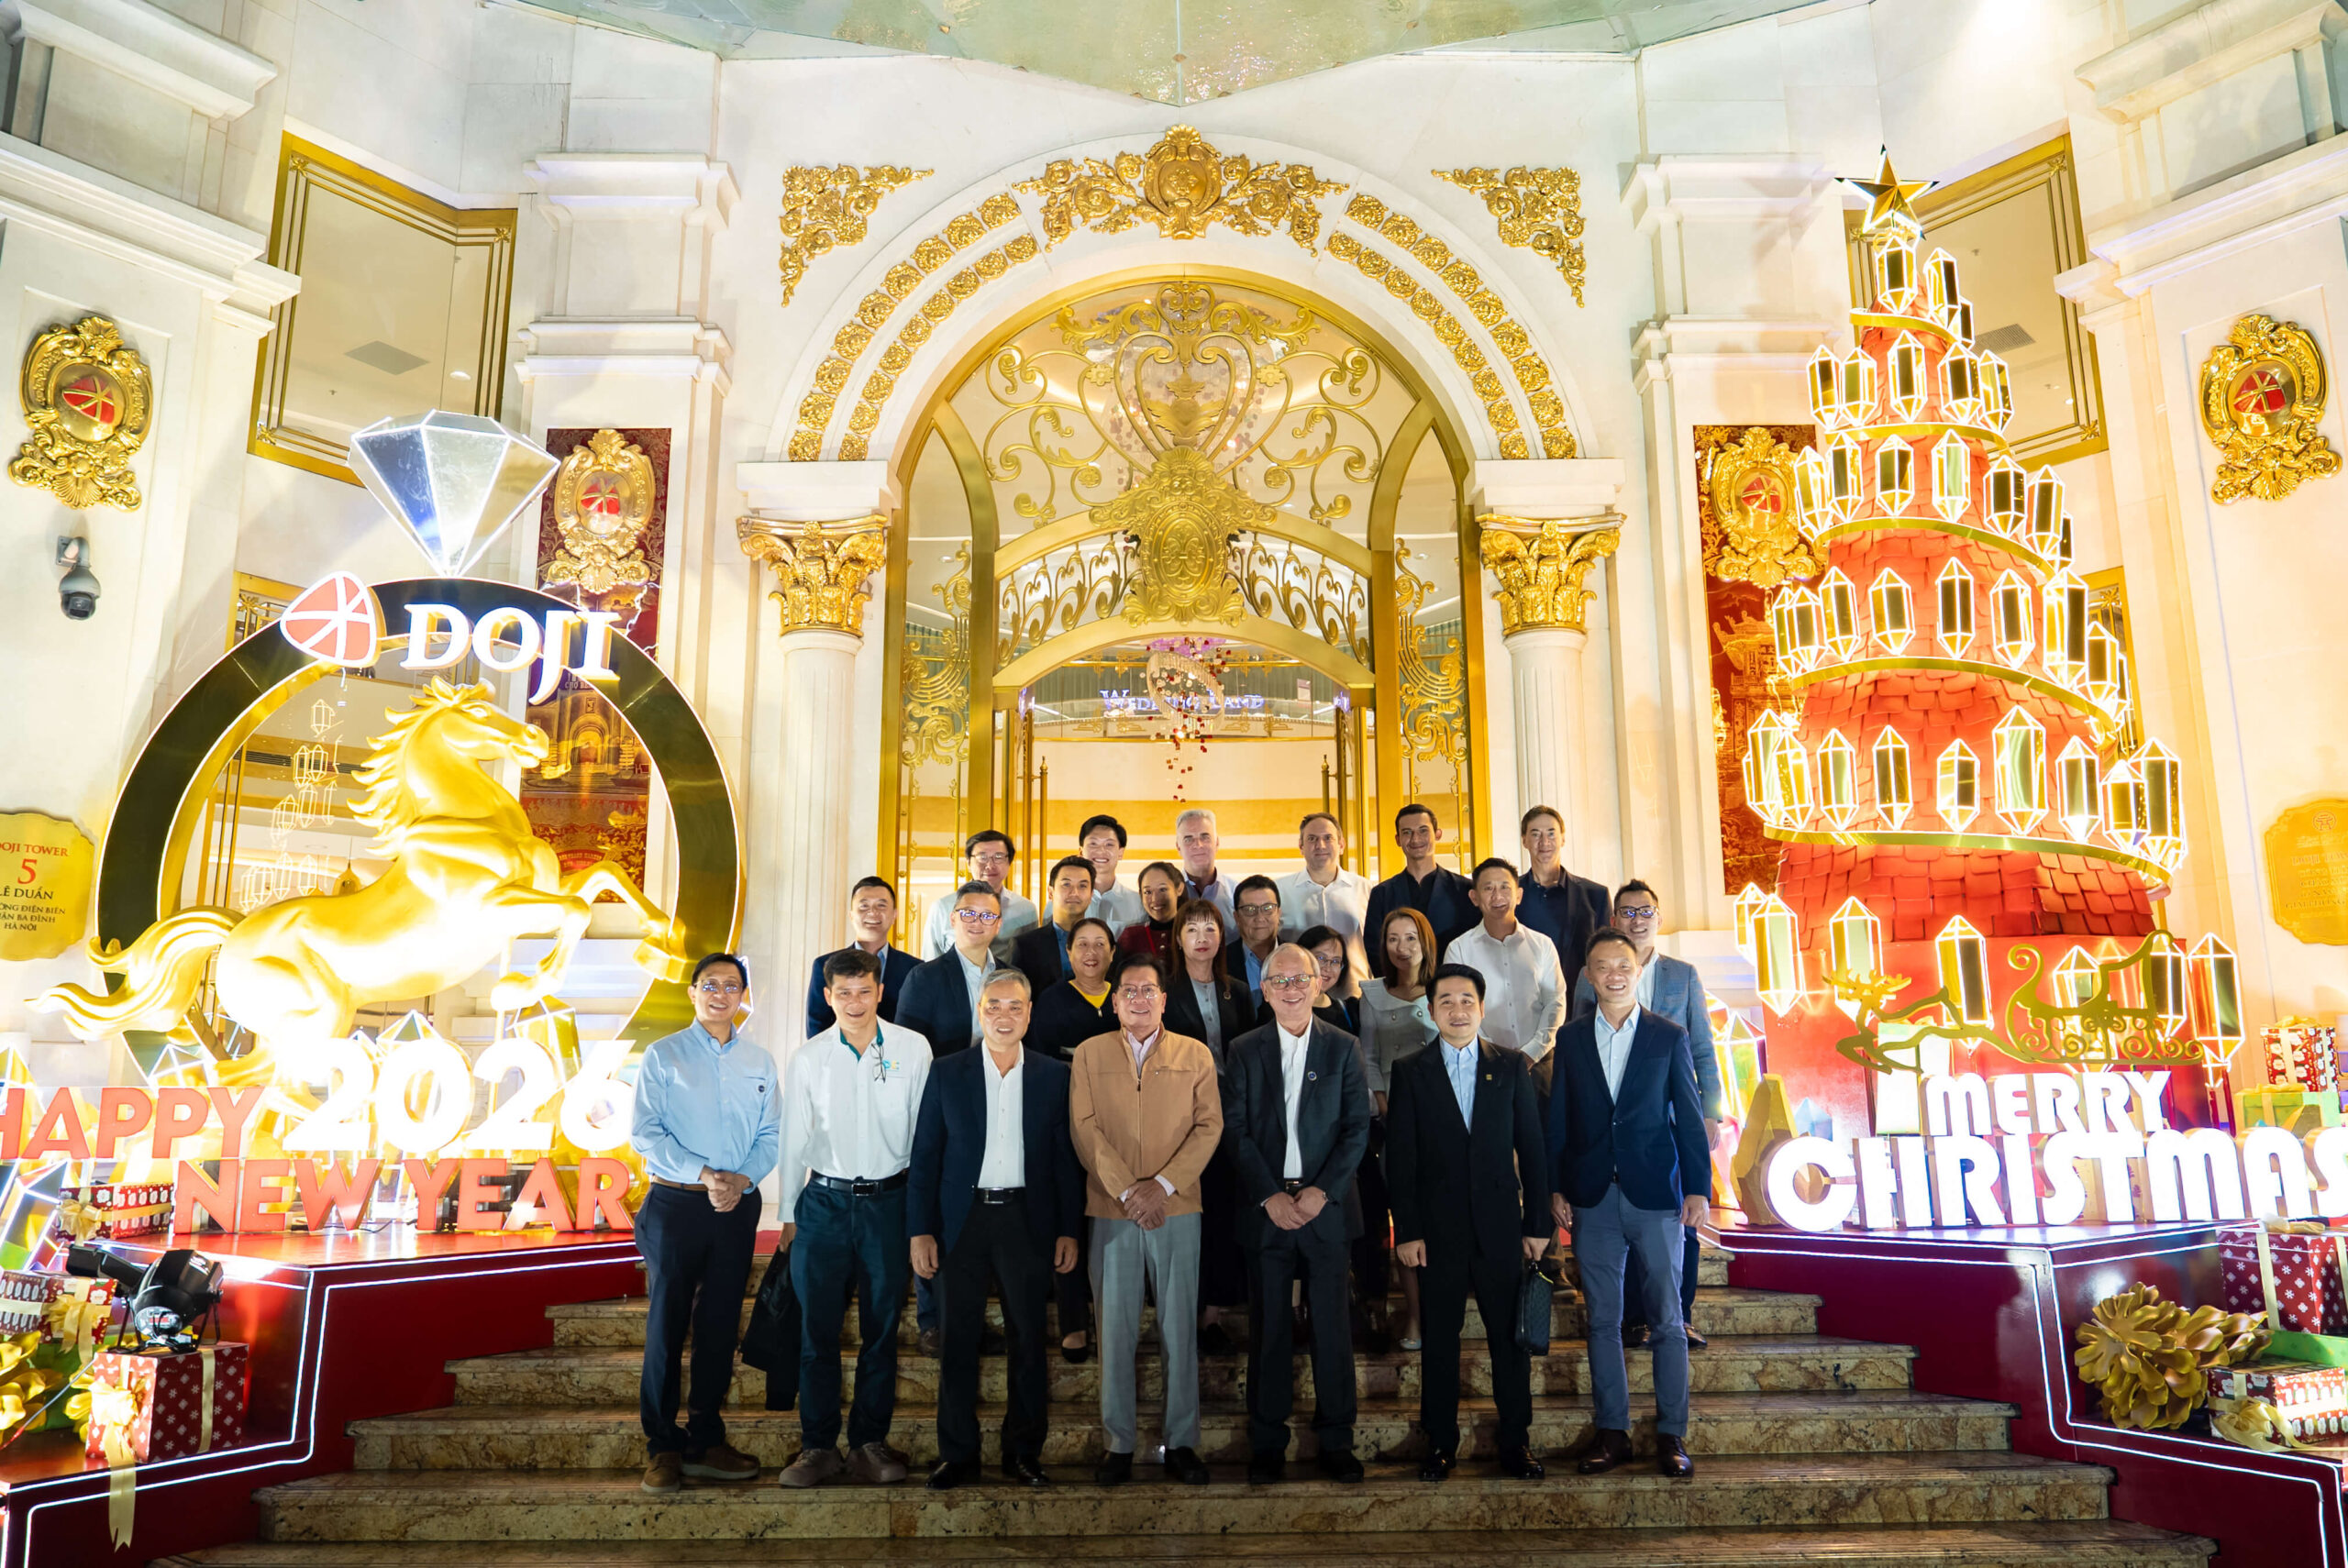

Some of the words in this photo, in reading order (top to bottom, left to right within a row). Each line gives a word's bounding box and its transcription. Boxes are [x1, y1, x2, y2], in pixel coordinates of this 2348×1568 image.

[400, 603, 620, 704] DOJI
[0, 842, 20, 854] OJI
[24, 844, 68, 856] TOWER
[17, 858, 37, 885] 5
[282, 1036, 635, 1152] 2026
[1922, 1070, 2171, 1137] MERRY
[174, 1158, 382, 1233] NEW
[402, 1157, 635, 1231] YEAR
[1766, 1126, 2348, 1232] CHRISTMAS
